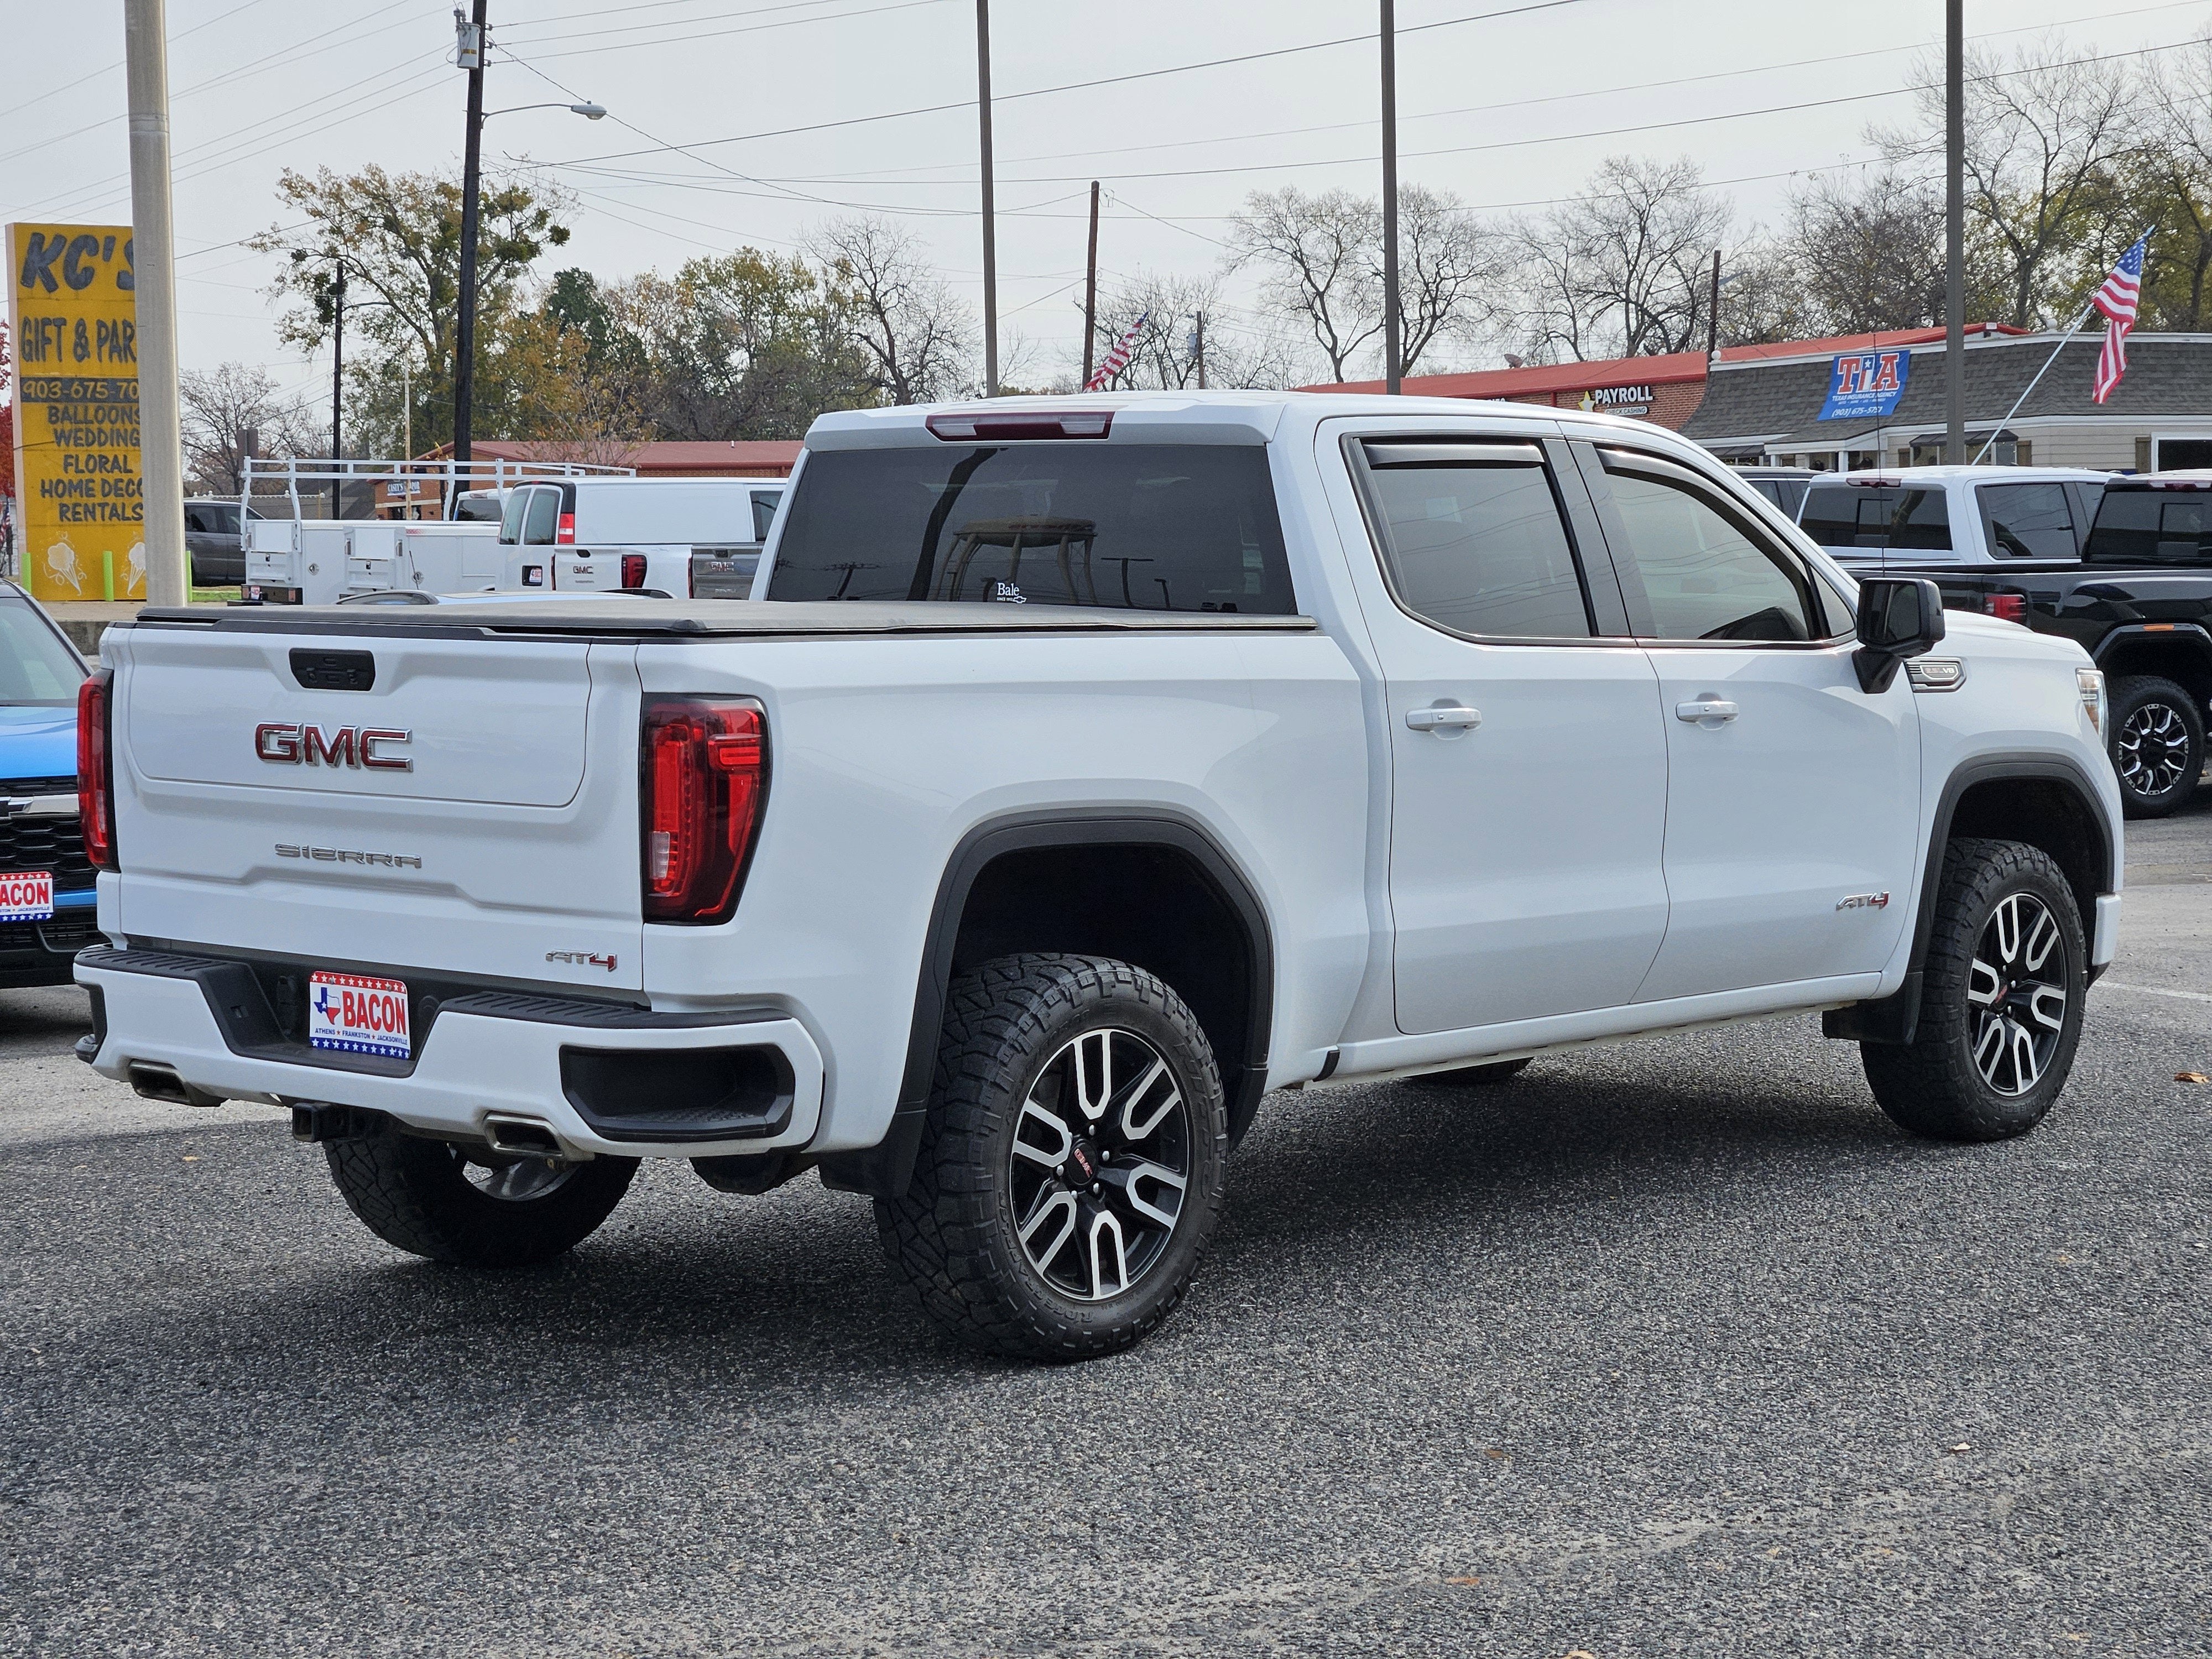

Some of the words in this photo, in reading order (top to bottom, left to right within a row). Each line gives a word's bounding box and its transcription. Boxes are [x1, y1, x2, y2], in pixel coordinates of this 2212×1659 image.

[21, 316, 67, 362] GIFT
[73, 318, 90, 362] &
[1837, 353, 1900, 394] TIA
[1595, 386, 1653, 404] PAYROLL
[1832, 408, 1851, 417] (903)
[63, 454, 133, 474] FLORAL
[40, 479, 96, 498] HOME
[59, 502, 143, 522] RENTALS
[573, 566, 593, 575] GMC
[711, 561, 734, 572] GMC
[997, 582, 1020, 596] Bale
[255, 721, 414, 773] GMC
[275, 843, 422, 869] SIERRA
[1836, 891, 1890, 911] AT4
[546, 948, 618, 972] AT4
[342, 990, 406, 1035] BACON
[342, 1030, 370, 1039] FRANKSTON
[377, 1035, 407, 1045] JACKSONVILLE
[1074, 1147, 1093, 1178] GMC
